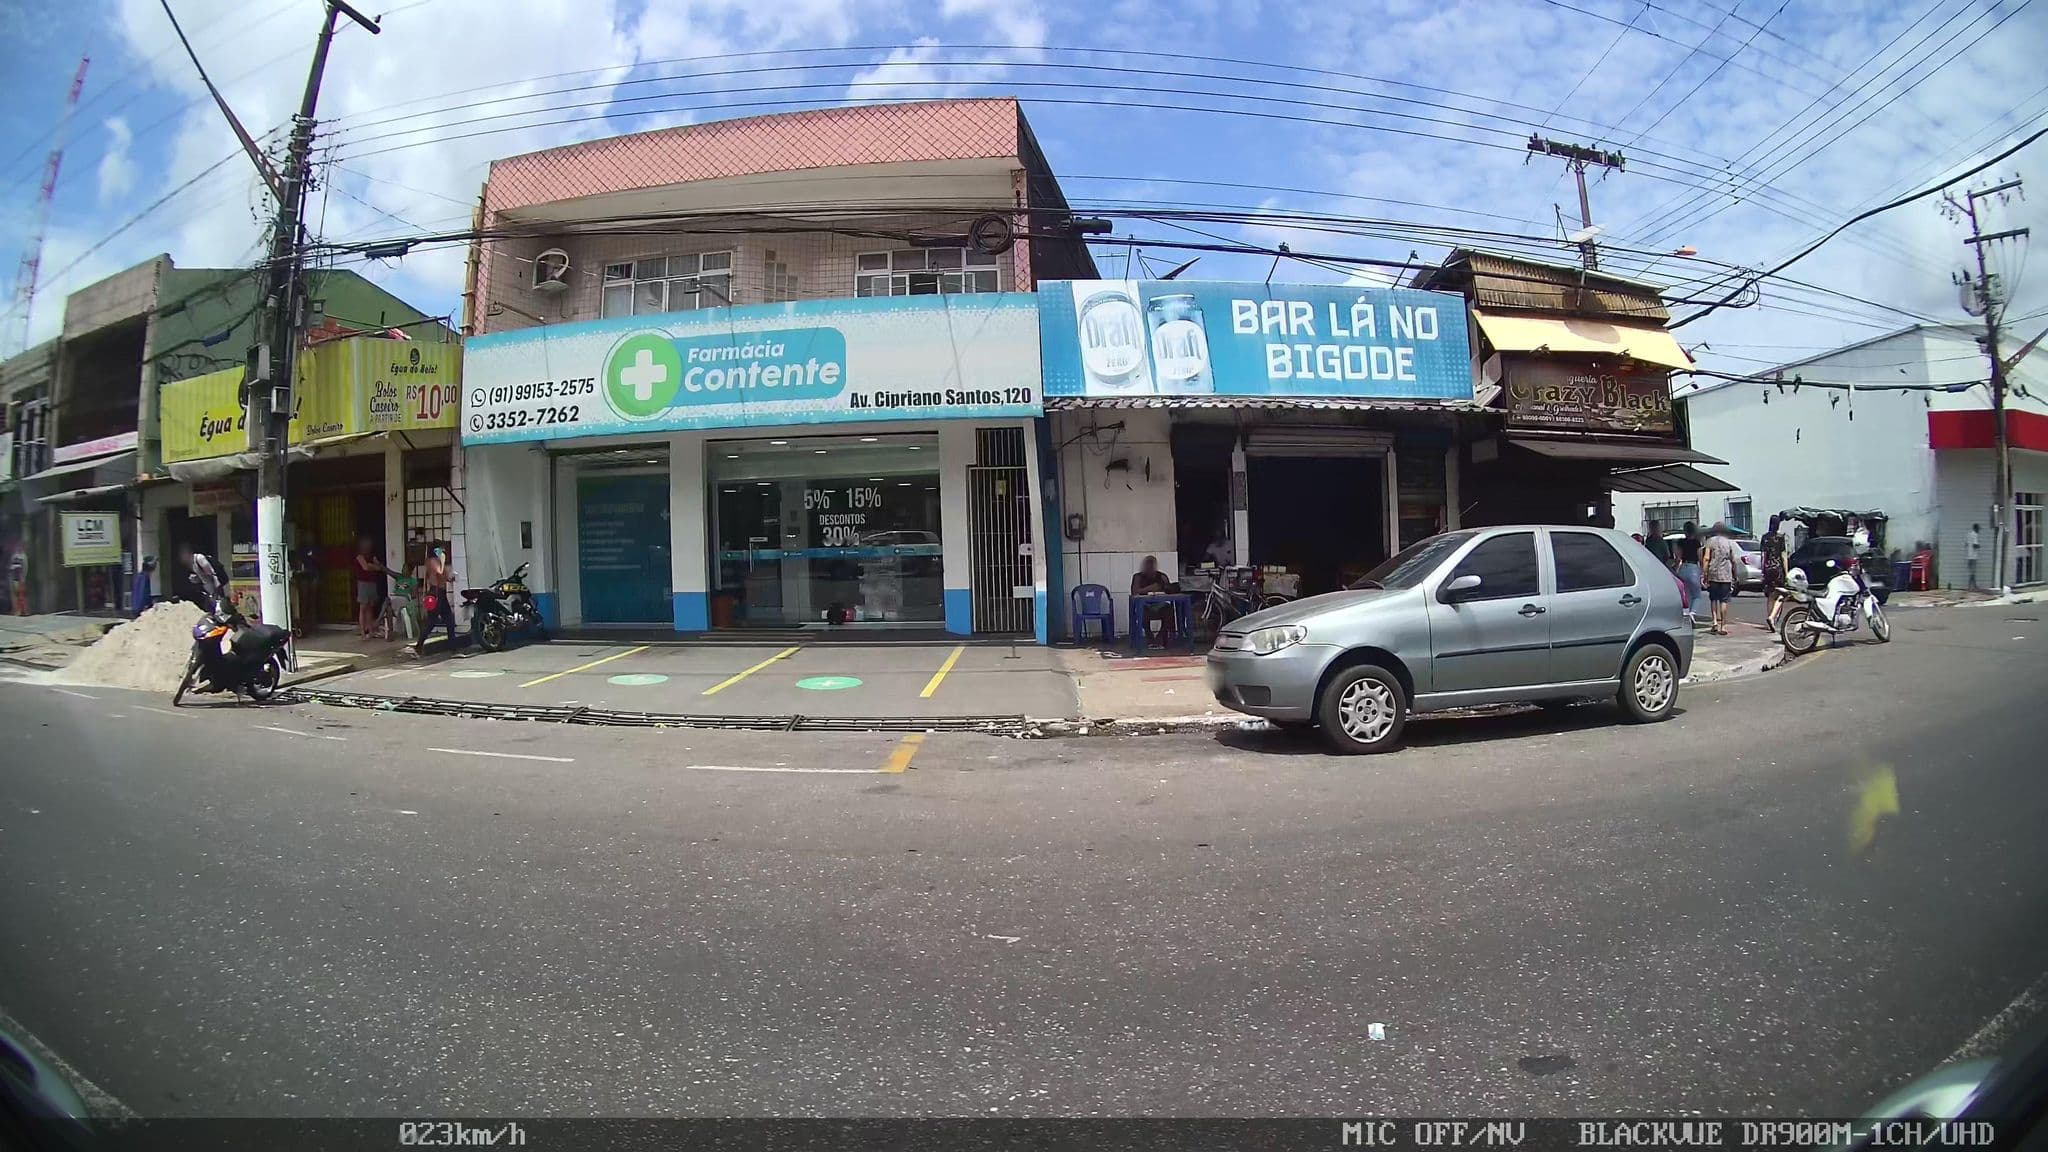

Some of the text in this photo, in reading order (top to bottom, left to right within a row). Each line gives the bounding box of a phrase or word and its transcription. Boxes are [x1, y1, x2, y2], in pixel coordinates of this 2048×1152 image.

[1231, 295, 1439, 340] BAR LÁ NO
[687, 339, 785, 363] Farmácia
[1266, 343, 1416, 382] BIGODE
[684, 357, 841, 392] Contente
[850, 391, 871, 408] Av.
[875, 390, 941, 409] Cipriano
[1600, 375, 1668, 412] Black
[200, 411, 232, 442] Égua
[486, 405, 580, 430] 3352-7262
[803, 487, 882, 509] 5% 15%
[820, 513, 866, 525] DESCONTOS
[822, 526, 860, 547] 30%
